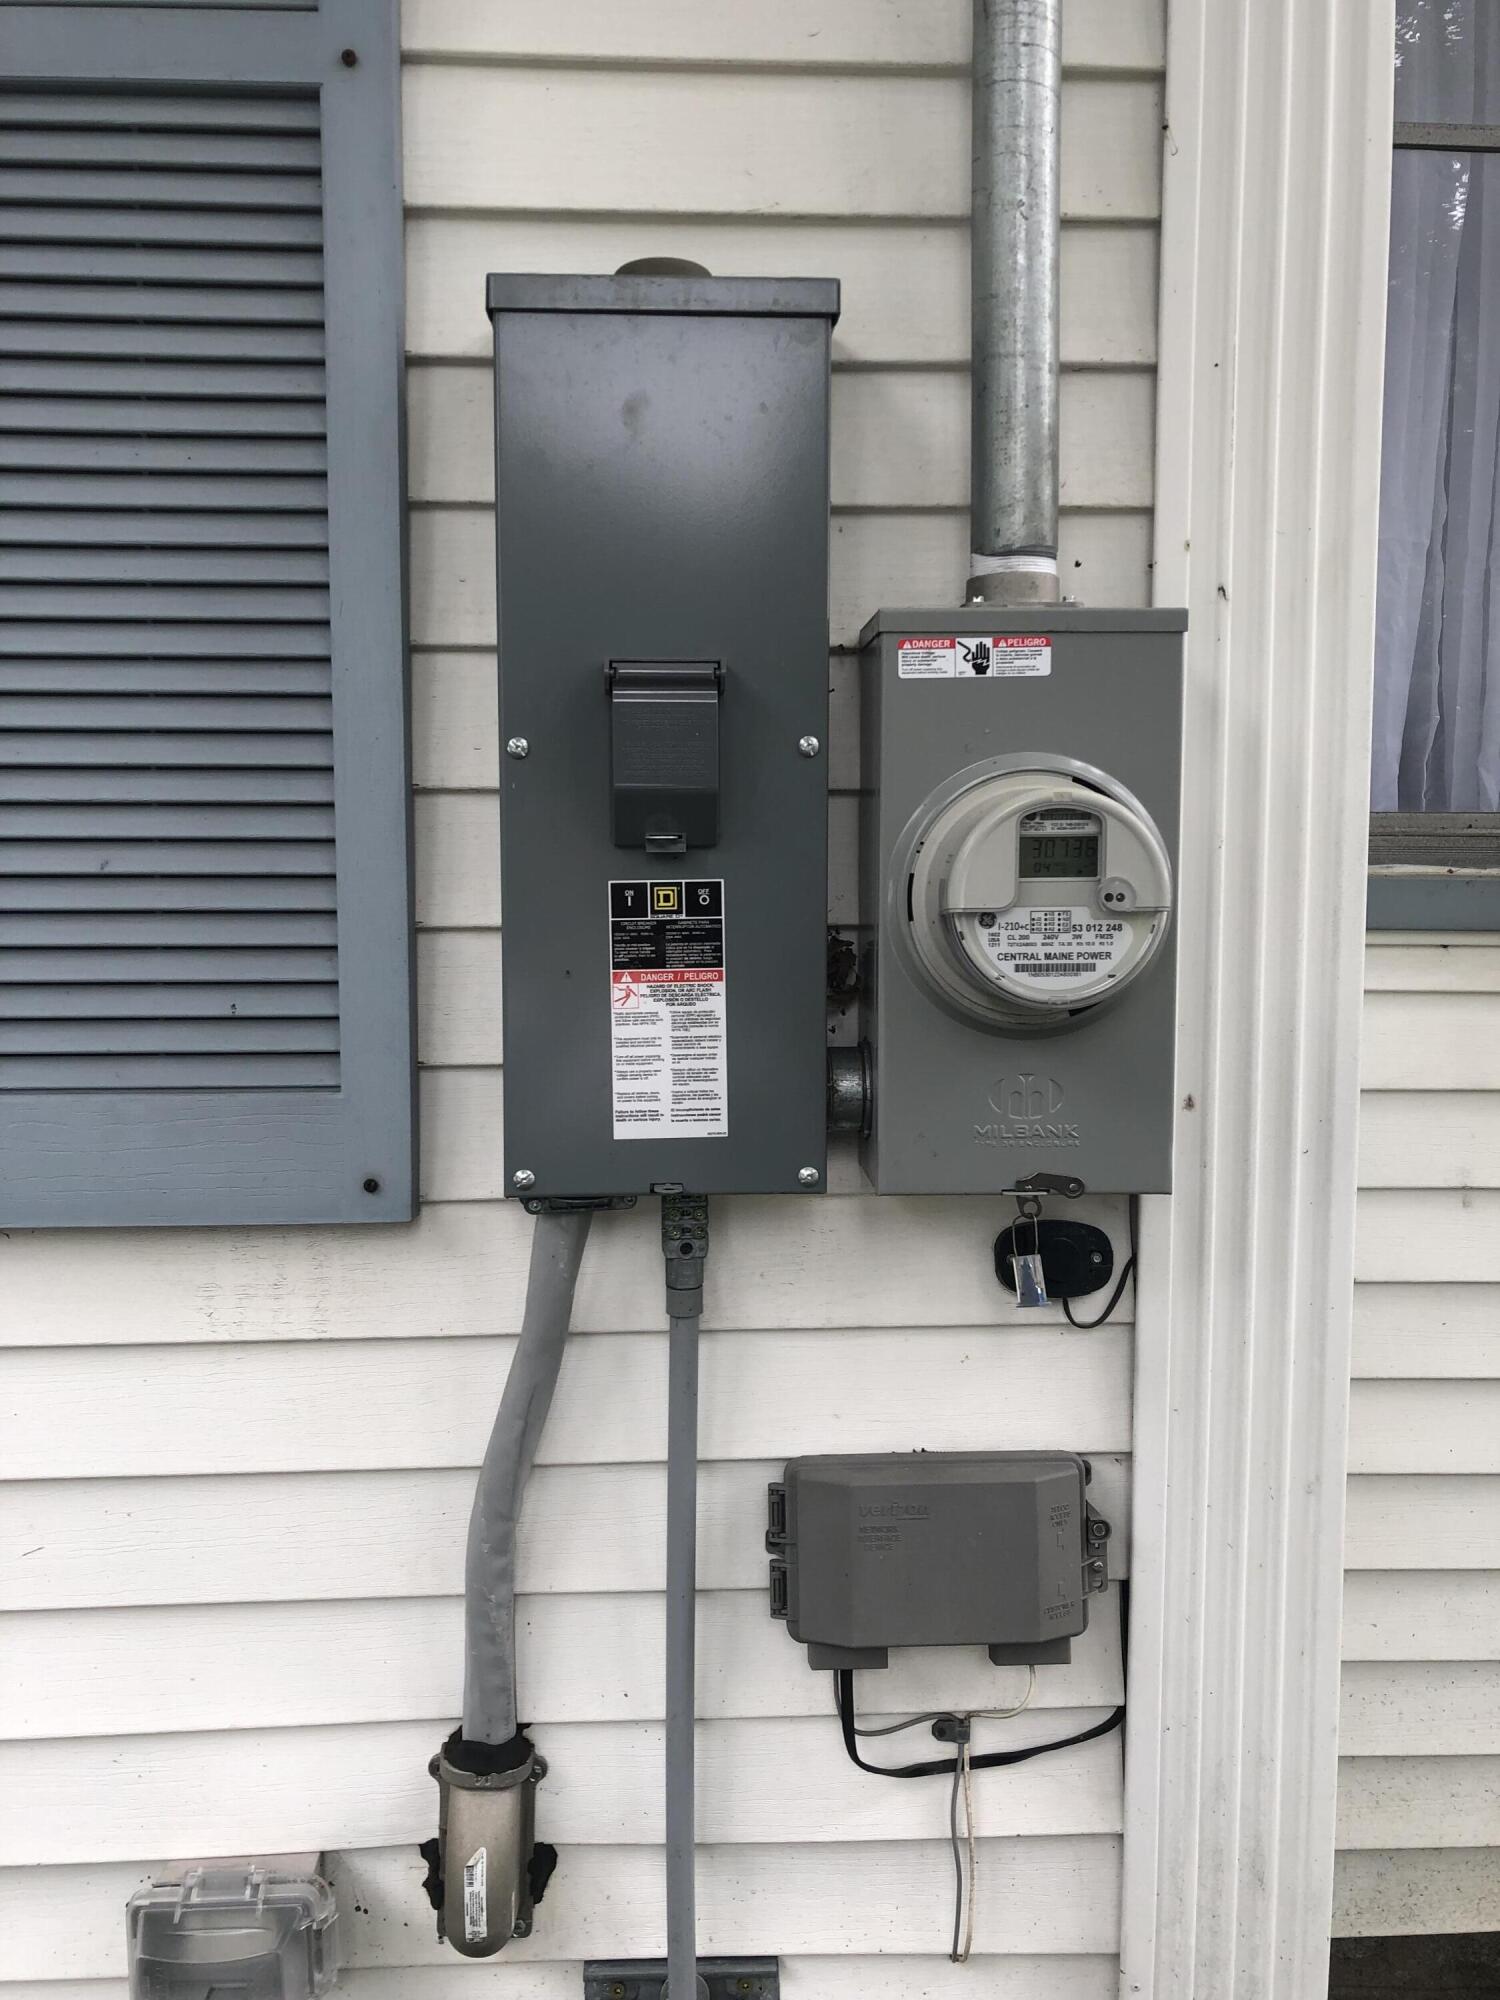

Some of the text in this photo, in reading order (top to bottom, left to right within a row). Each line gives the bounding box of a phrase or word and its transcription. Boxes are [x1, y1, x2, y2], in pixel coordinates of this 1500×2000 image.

[912, 640, 950, 649] DANGER
[1008, 638, 1046, 647] PELIGRO
[1072, 923, 1123, 932] 53 012 248
[996, 952, 1112, 961] CENTRAL MAINE POWER
[640, 973, 674, 981] DANGER
[684, 972, 719, 980] PELIGRO
[973, 1124, 1080, 1138] MILBANK
